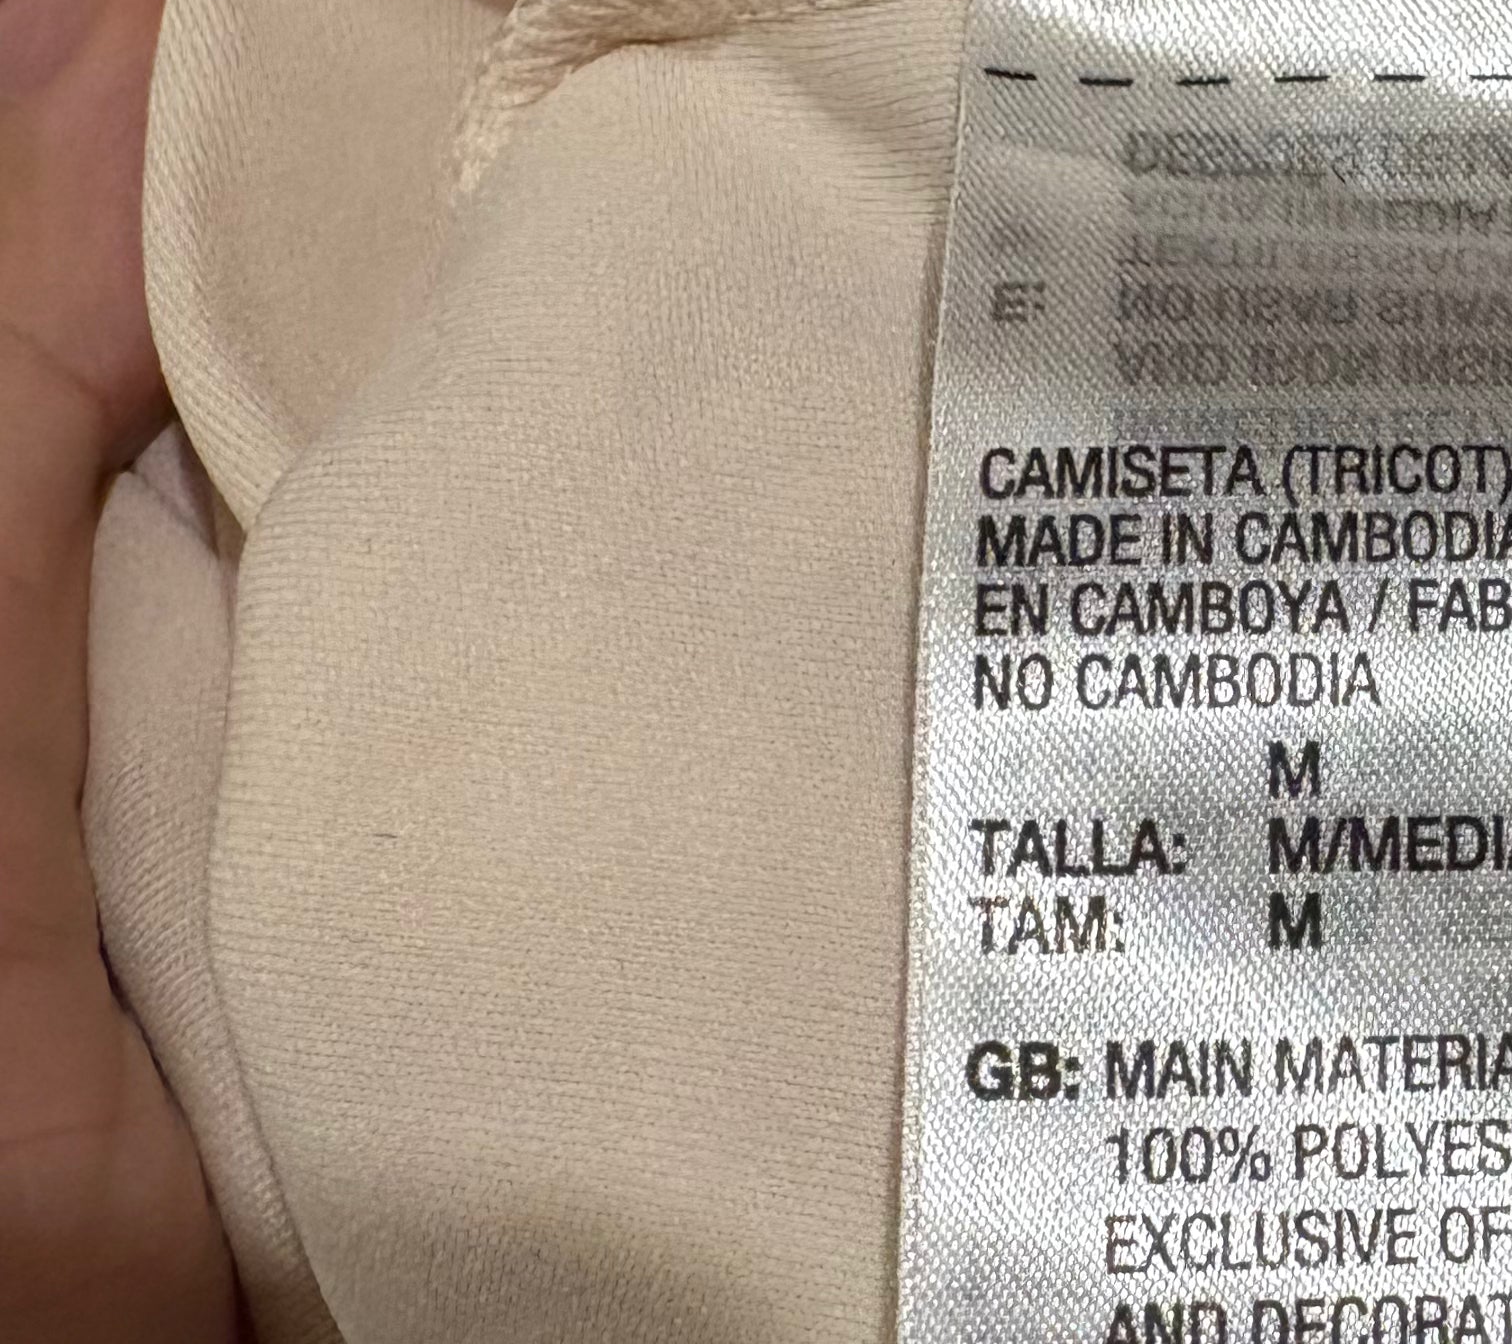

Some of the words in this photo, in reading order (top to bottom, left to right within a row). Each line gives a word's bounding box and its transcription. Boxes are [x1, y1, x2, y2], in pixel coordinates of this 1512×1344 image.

[979, 448, 1265, 499] CAMISETA
[976, 513, 1140, 568] MADE
[1161, 512, 1214, 565] IN
[974, 581, 1047, 636] EN
[1070, 579, 1351, 635] CAMBOYA
[972, 654, 1053, 712] NO
[1077, 654, 1381, 710] CAMBODIA
[1267, 741, 1322, 799] M
[969, 818, 1188, 877] TALLA:
[968, 895, 1125, 953] TAM:
[1267, 894, 1323, 950] M
[965, 1042, 1080, 1100] GB:
[1105, 1040, 1251, 1098] MAIN
[1105, 1125, 1271, 1185] 100%
[1105, 1209, 1416, 1275] EXCLUSIVE
